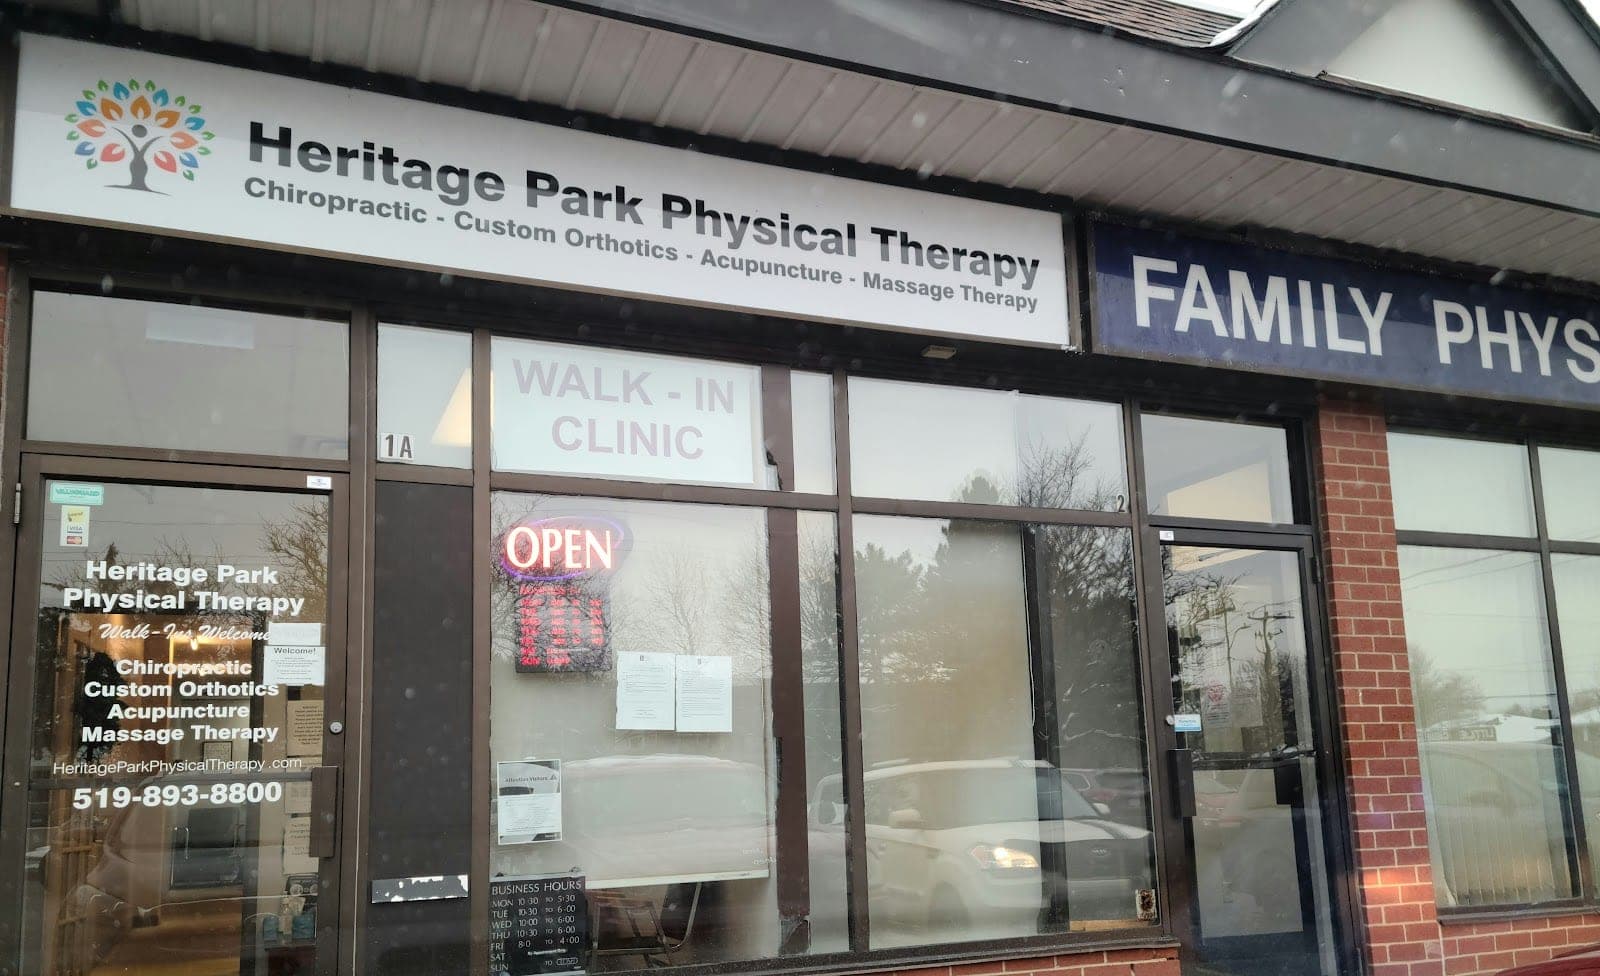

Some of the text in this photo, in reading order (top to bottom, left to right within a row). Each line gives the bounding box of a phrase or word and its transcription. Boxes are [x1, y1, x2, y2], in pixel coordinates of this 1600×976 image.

[249, 121, 1040, 291] Heritage Park Physical Therapy
[244, 177, 427, 223] Chiropractic
[454, 211, 556, 243] Custom
[564, 228, 678, 261] Orthotics
[700, 248, 843, 285] Acupuncture
[863, 271, 955, 302] Massage
[960, 284, 1038, 314] Therapy
[1132, 255, 1600, 385] FAMILY PHYS
[512, 358, 653, 406] WALK
[695, 377, 734, 414] IN
[385, 434, 412, 458] 1A
[551, 415, 704, 460] CLINIC
[1117, 494, 1126, 512] 2
[506, 526, 612, 569] OPEN
[86, 560, 279, 586] Heritage Park
[63, 588, 305, 616] Physical Therapy
[197, 624, 271, 641] Welcome
[116, 659, 252, 678] Chiropractic
[84, 681, 279, 697] Custom Orthotics
[107, 703, 250, 722] Acupuncture
[82, 726, 184, 744] Massage
[190, 724, 279, 742] Therapy
[72, 781, 282, 810] 519-893-8800
[491, 880, 582, 895] BUSINESS HOURS
[492, 899, 514, 908] MON
[493, 909, 508, 918] TUE
[491, 920, 512, 928] WED
[491, 931, 511, 939] THU
[490, 942, 504, 951] FRI
[490, 952, 506, 961] SAT
[490, 963, 509, 971] SUN
